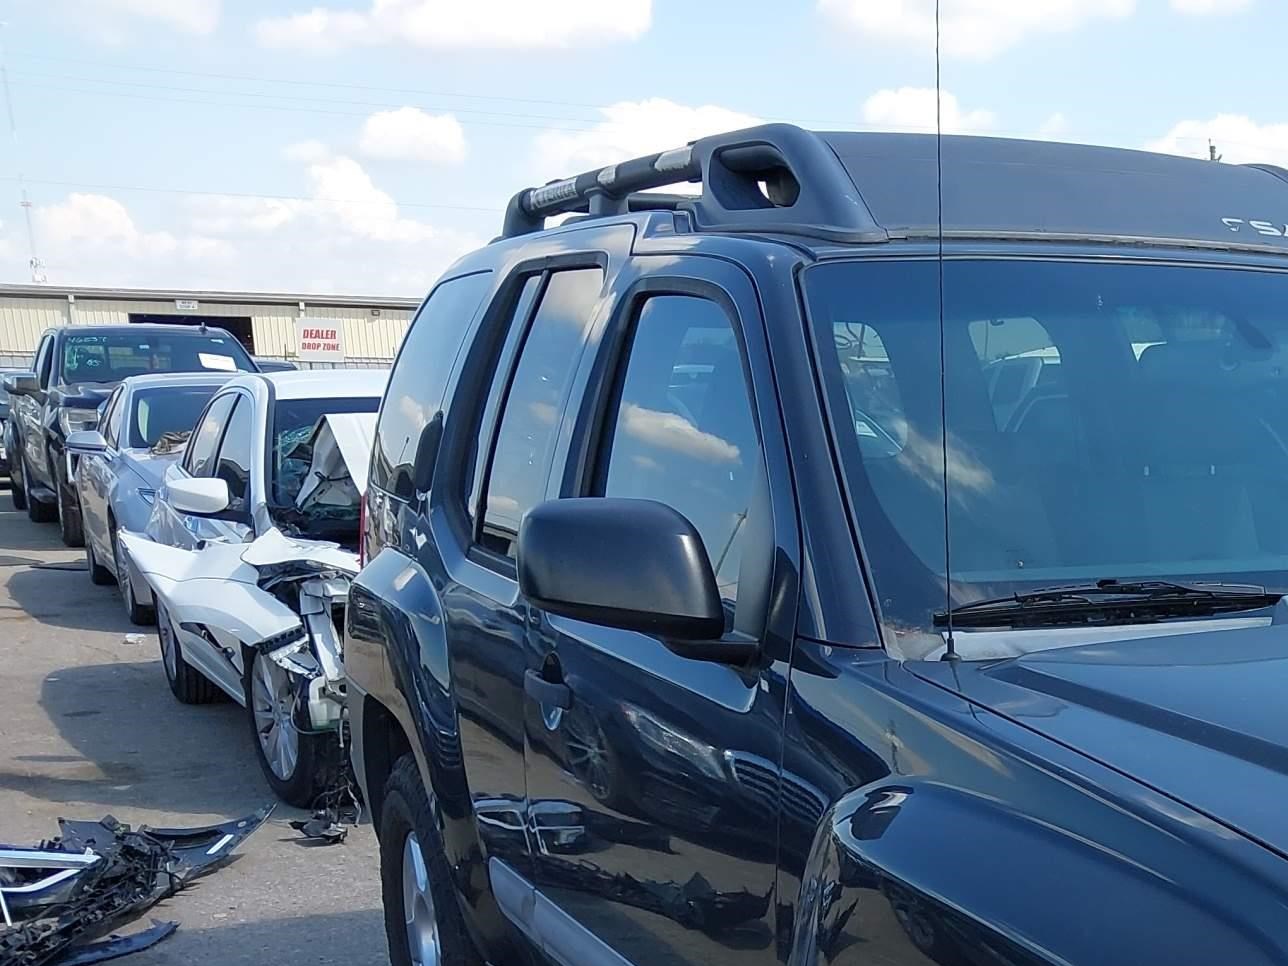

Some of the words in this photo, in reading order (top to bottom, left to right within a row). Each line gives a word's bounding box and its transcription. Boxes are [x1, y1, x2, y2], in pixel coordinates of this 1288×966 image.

[302, 328, 337, 340] DEALER
[301, 342, 321, 351] DROP
[322, 343, 341, 352] ZONE
